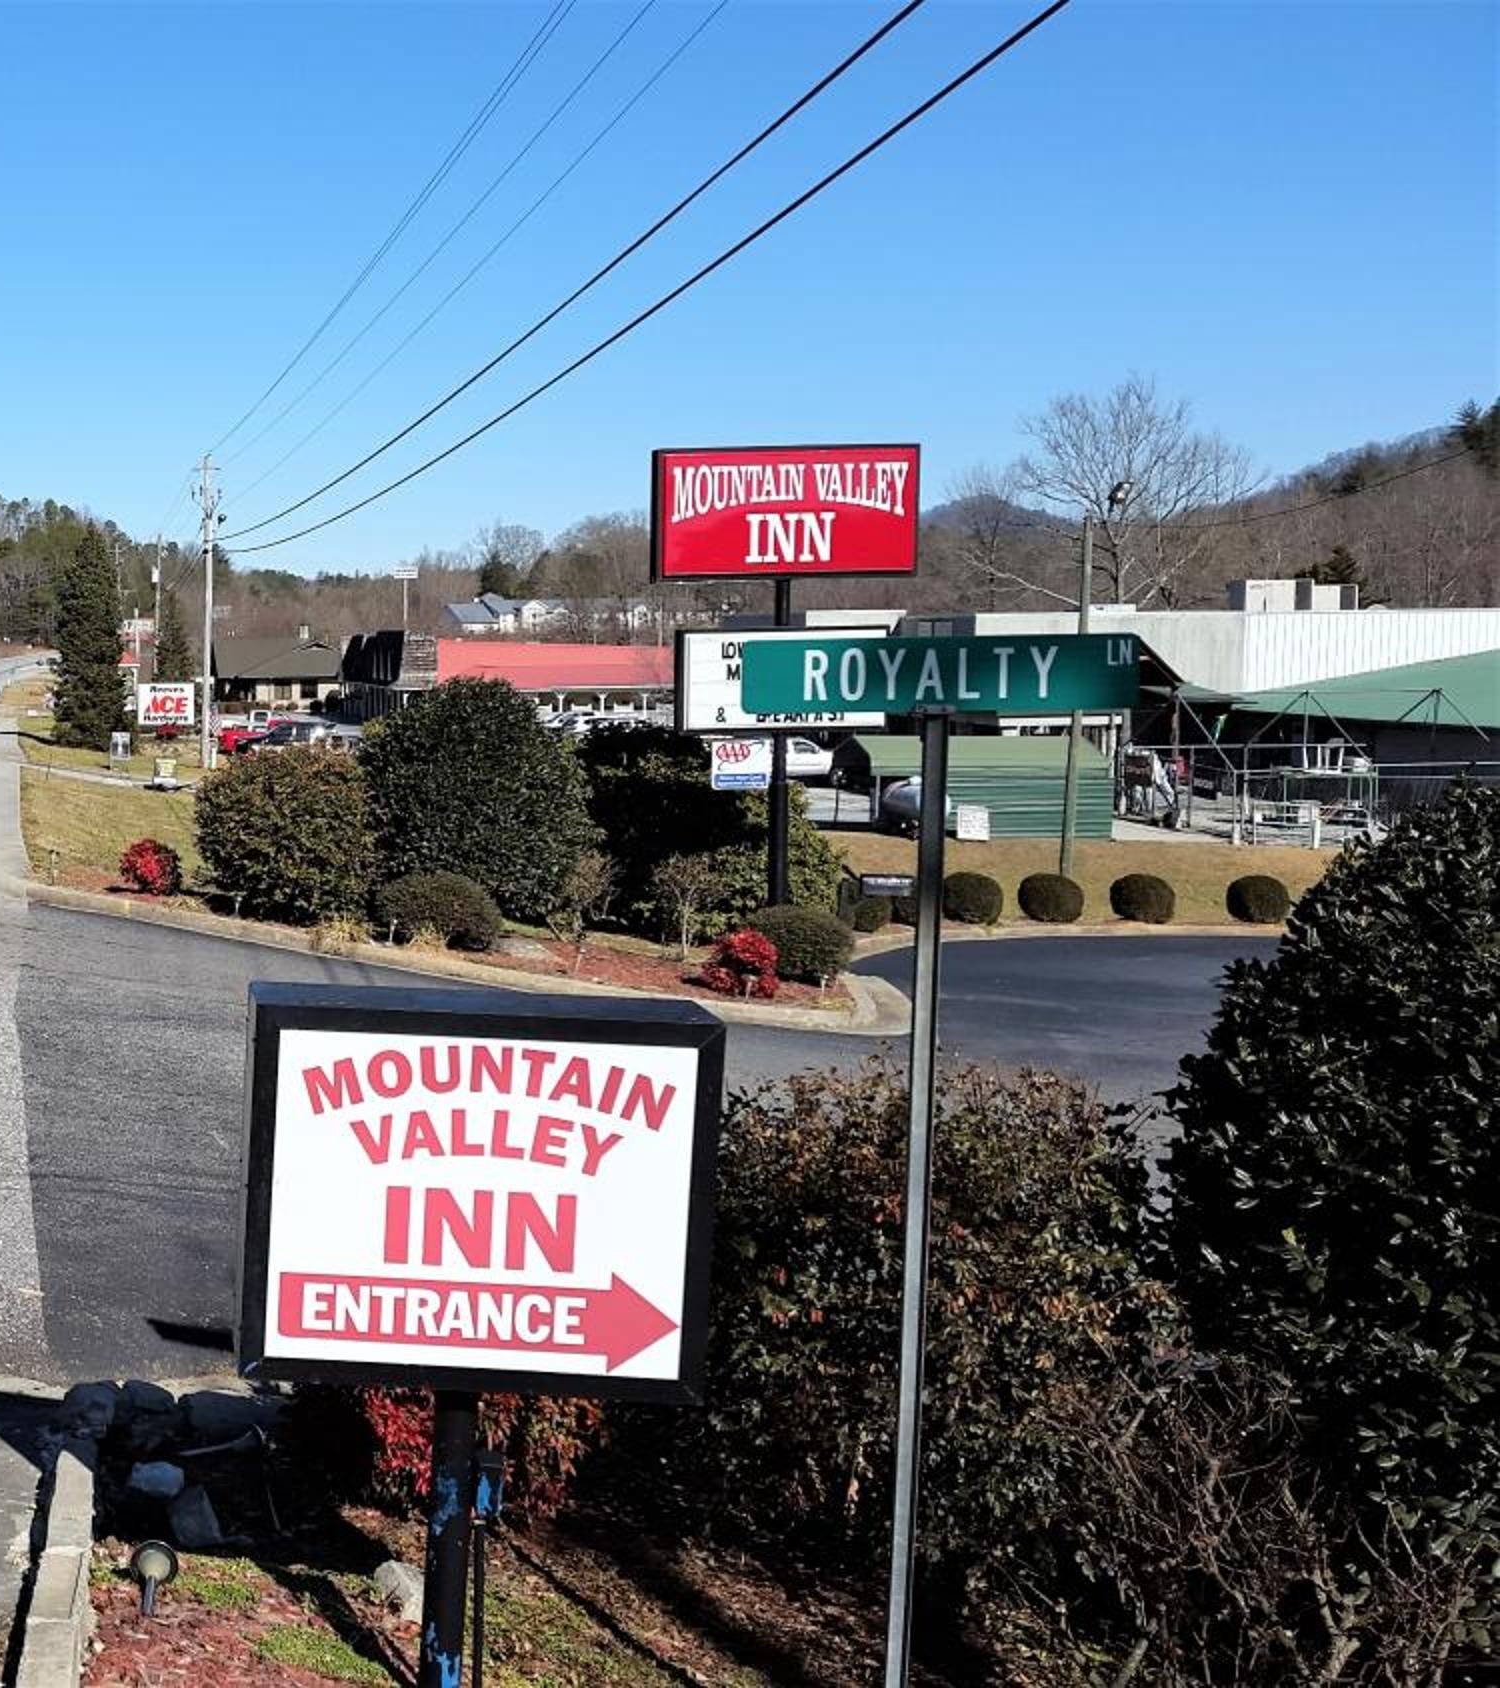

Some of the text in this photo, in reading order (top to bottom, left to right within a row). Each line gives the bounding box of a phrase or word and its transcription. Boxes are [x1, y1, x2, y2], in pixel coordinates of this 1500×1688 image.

[672, 461, 909, 523] MOUNTAIN VALLEY
[745, 512, 836, 563] INN
[803, 639, 1134, 701] ROYALTY LN
[145, 695, 189, 714] ACE
[715, 706, 726, 723] &
[717, 743, 750, 763] AAA
[302, 1045, 676, 1131] MOUNTAIN
[350, 1109, 623, 1177] VALLEY
[383, 1185, 578, 1273] INN
[302, 1283, 587, 1345] ENTRANCE
